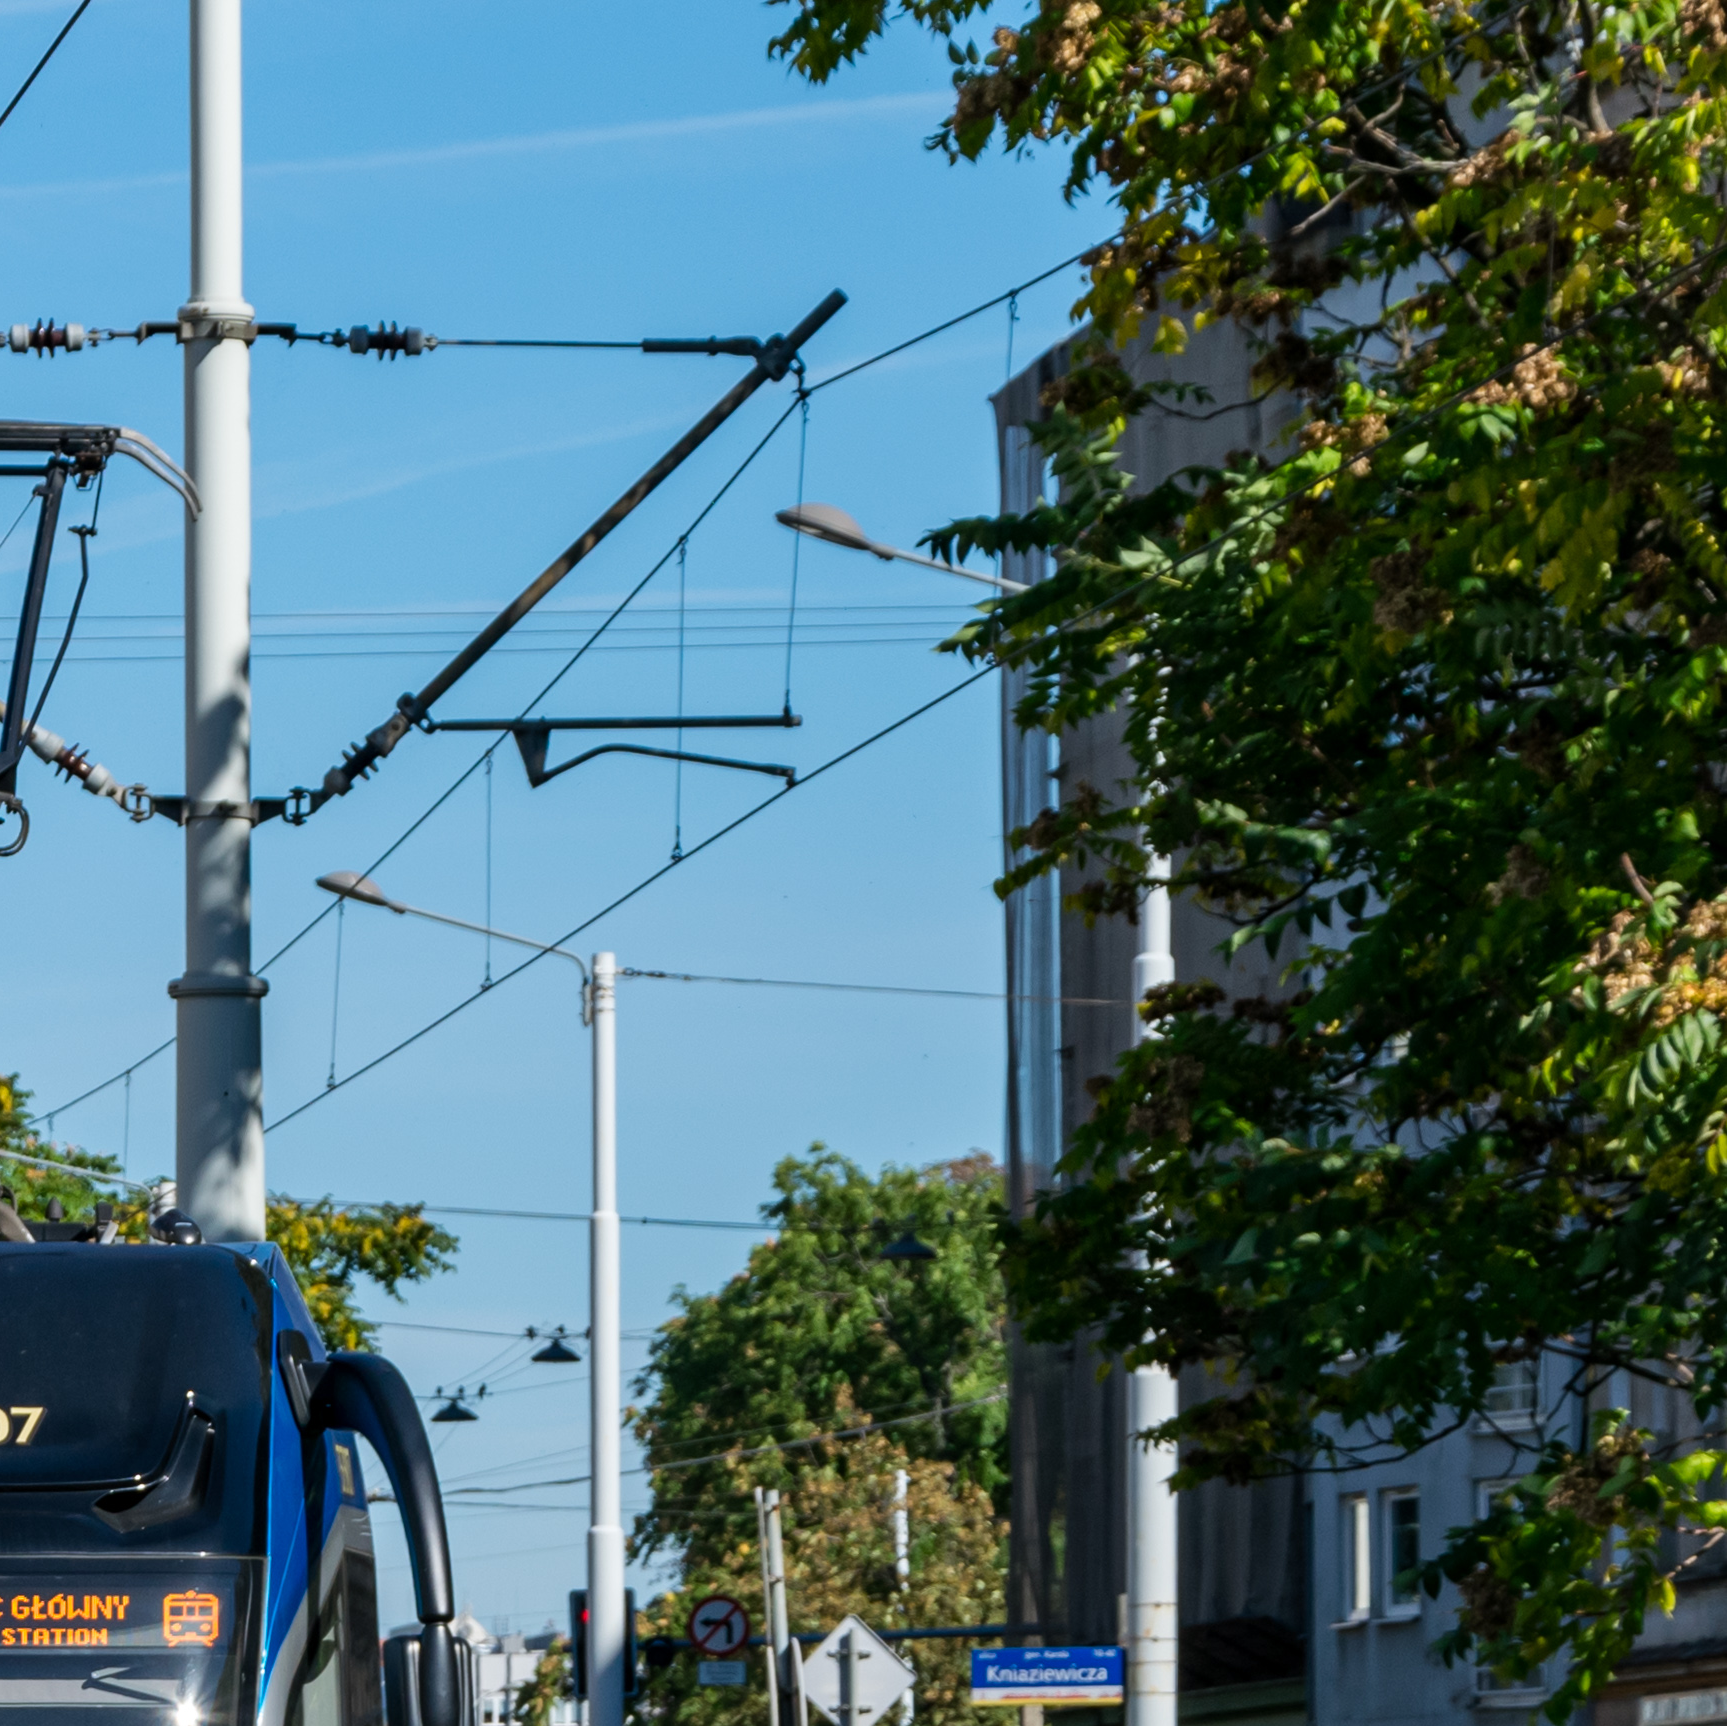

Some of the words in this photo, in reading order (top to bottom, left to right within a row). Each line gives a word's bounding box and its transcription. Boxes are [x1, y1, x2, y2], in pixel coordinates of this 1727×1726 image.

[11, 1592, 130, 1620] GŁÓWNY
[1, 1628, 108, 1645] STATION
[986, 1662, 1108, 1683] Kniaziewicza
